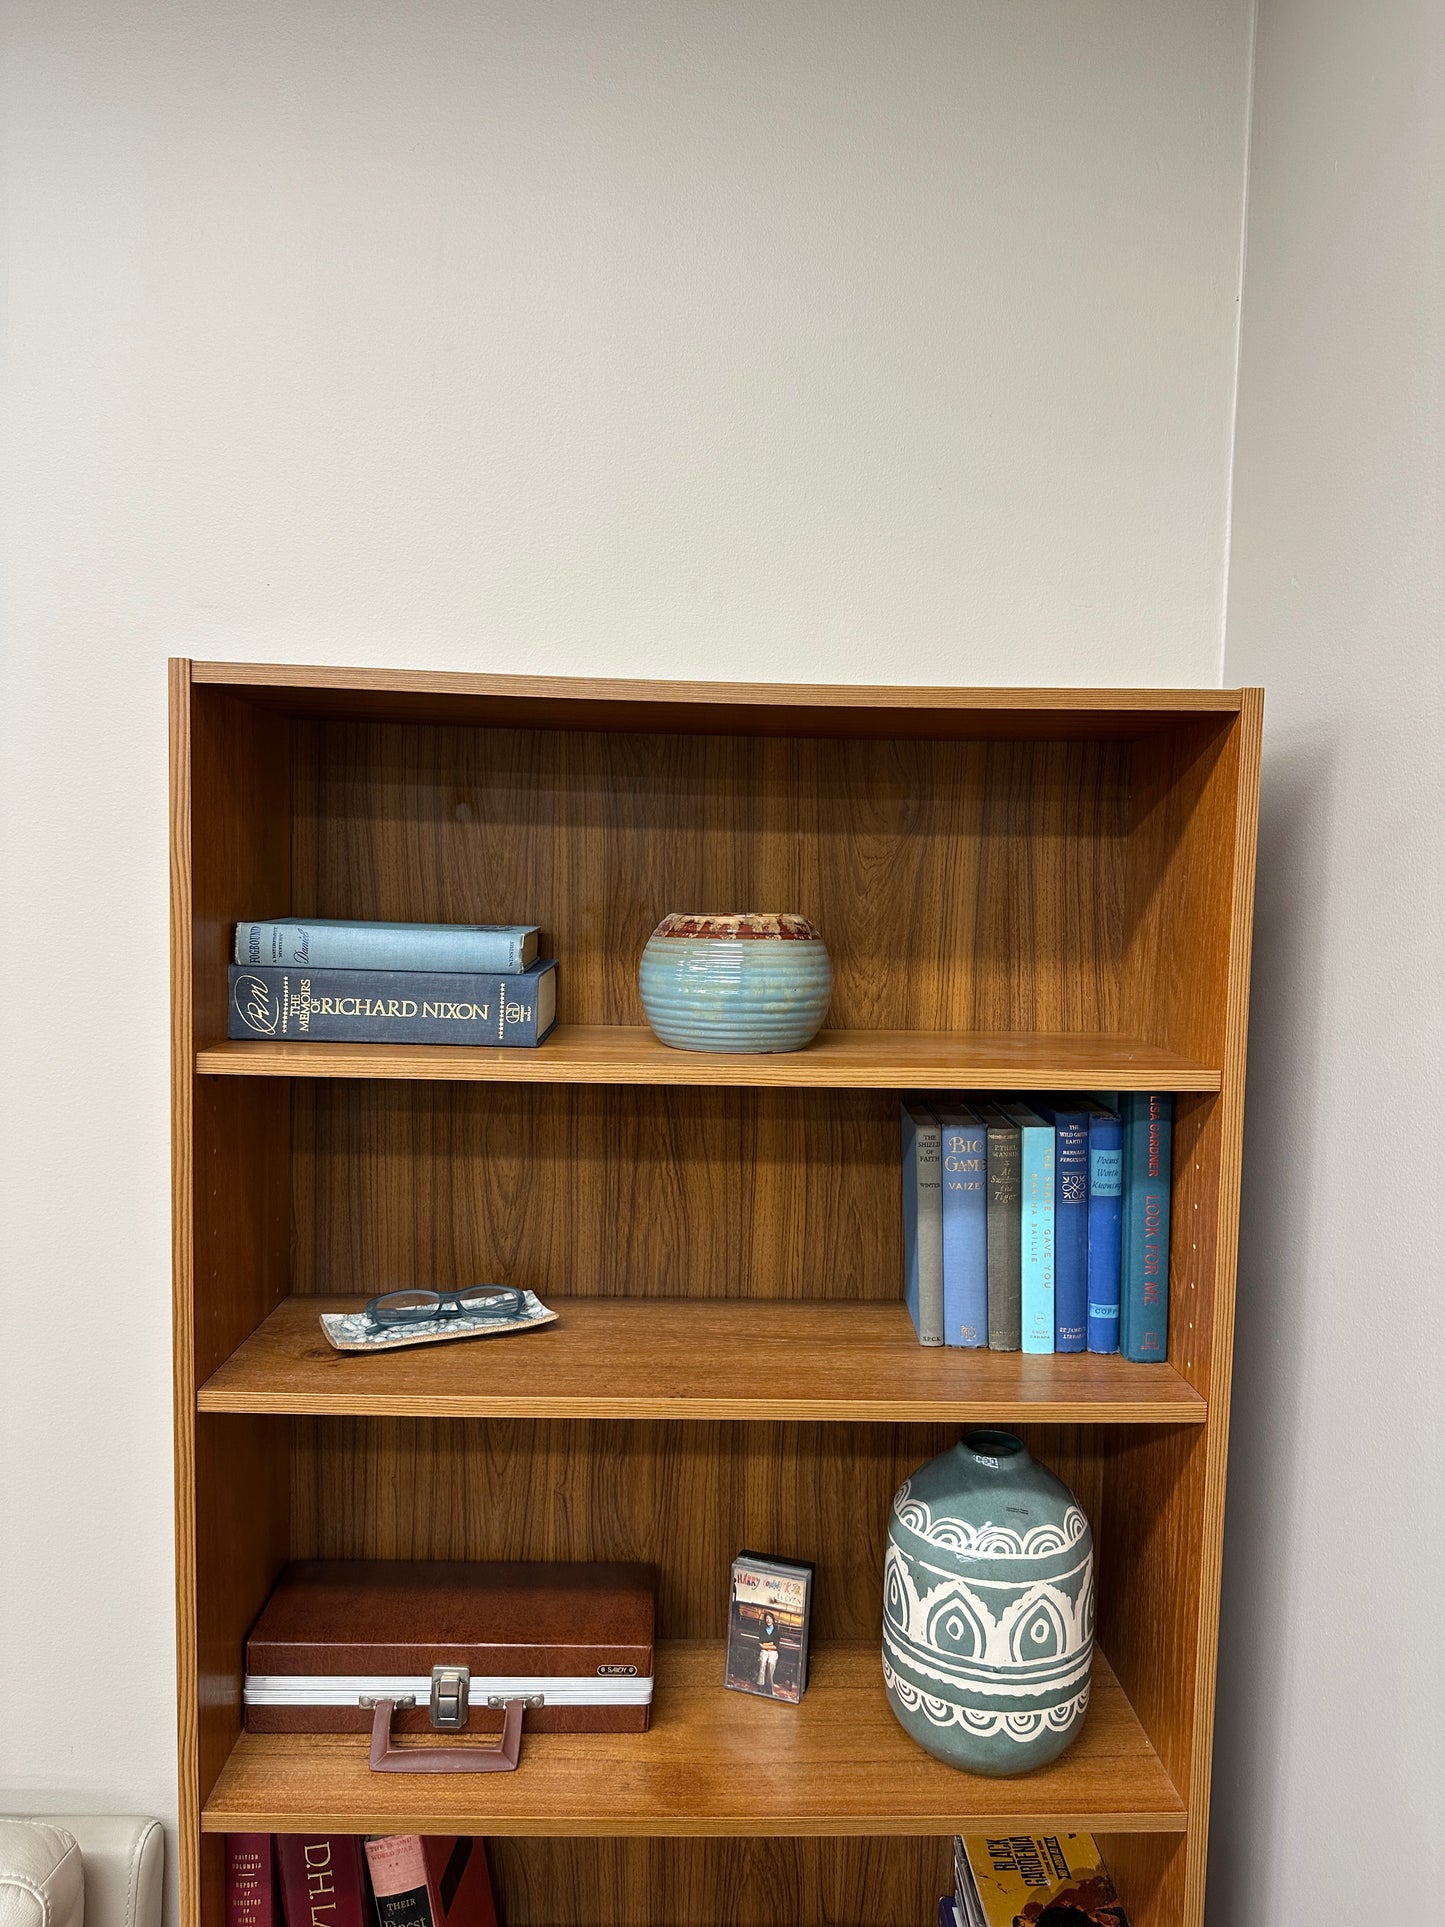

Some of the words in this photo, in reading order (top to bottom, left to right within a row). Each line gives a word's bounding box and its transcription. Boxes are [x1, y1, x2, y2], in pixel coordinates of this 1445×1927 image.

[249, 926, 261, 963] FOGBOUND
[293, 927, 309, 964] Daniel
[289, 994, 300, 1016] THE
[299, 978, 311, 1032] MEMOIRS
[310, 998, 320, 1013] OF
[319, 997, 418, 1018] RICHARD
[421, 1001, 490, 1020] NIXON
[1149, 1095, 1160, 1121] LISA
[1044, 1148, 1052, 1168] THE
[1097, 1156, 1119, 1164] Poems
[1148, 1123, 1160, 1177] GARDNER
[1097, 1168, 1119, 1177] Worth
[994, 1191, 1017, 1204] Tiger
[1145, 1195, 1160, 1238] LOOK
[1044, 1229, 1052, 1258] GAVE
[1144, 1244, 1159, 1275] FOR
[1044, 1266, 1052, 1289] YOU
[1143, 1282, 1159, 1306] ME
[985, 1838, 1019, 1871] BLACK
[386, 1898, 417, 1911] THEIR
